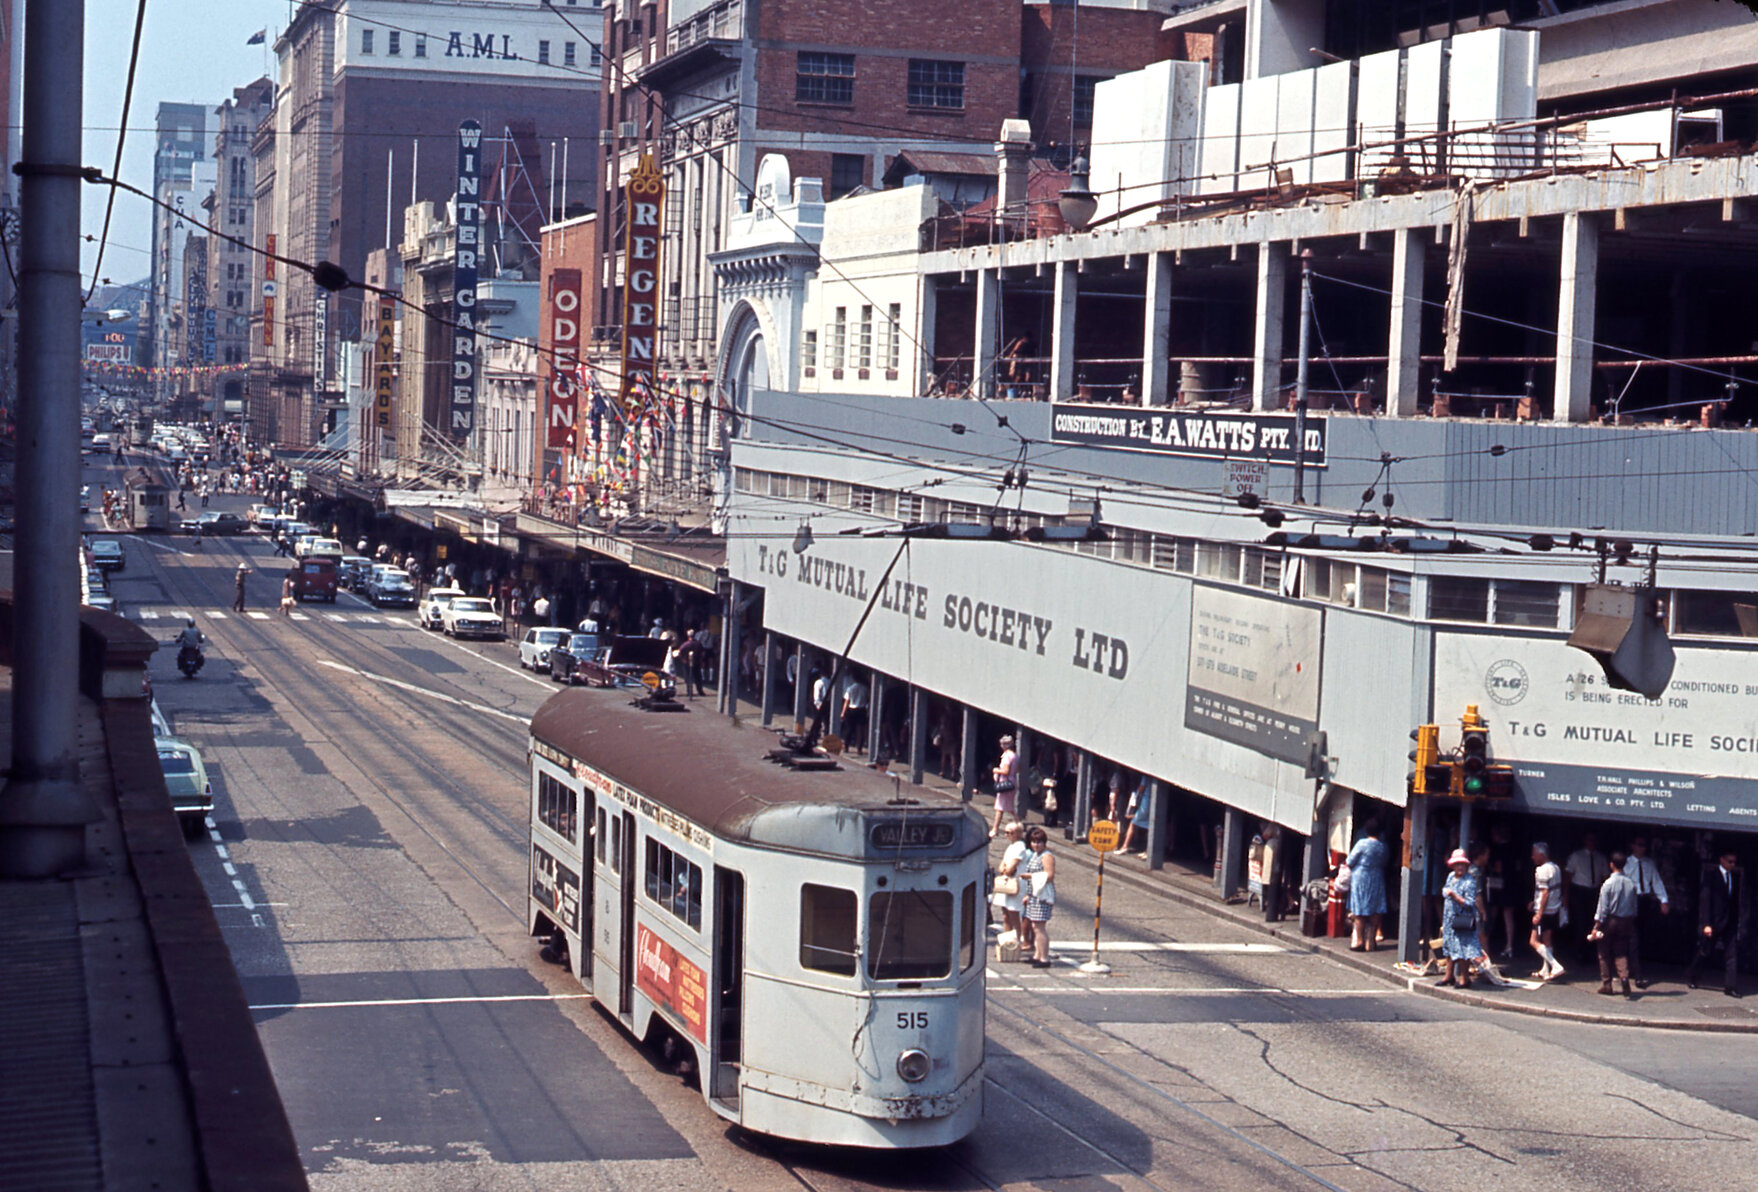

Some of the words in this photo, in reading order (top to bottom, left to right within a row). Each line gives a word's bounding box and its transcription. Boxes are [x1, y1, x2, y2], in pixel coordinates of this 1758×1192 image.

[445, 31, 523, 60] A.M.L.
[457, 128, 481, 269] WINTER
[89, 346, 122, 359] PHILIPS
[452, 289, 475, 428] GARDEN
[552, 289, 577, 427] ODEON
[379, 307, 393, 425] BAYARDS
[1055, 414, 1127, 437] CONSTRUCTION
[1260, 427, 1290, 449] PTY.
[1230, 473, 1261, 483] POWER
[798, 554, 867, 602] MUTUAL
[881, 577, 928, 621] LIFE
[944, 593, 1053, 656] SOCIETY
[1073, 627, 1129, 681] LTD
[1566, 674, 1575, 684] A
[1579, 674, 1594, 684] 26
[1671, 680, 1739, 694] CONDITIONED
[1565, 691, 1575, 701] IS
[1582, 692, 1611, 704] BEING
[1669, 698, 1688, 709] FOR
[1564, 725, 1637, 744] MUTUAL
[1654, 731, 1693, 748] LIFE
[1710, 736, 1758, 753] SOCI
[1519, 769, 1545, 778] TURNER
[1597, 785, 1627, 794] ASSOCIATE
[1633, 787, 1672, 798] ARCHITECTS
[1669, 780, 1695, 789] WILSON
[1547, 793, 1570, 802] ISLES
[1578, 795, 1598, 804] LOVE
[1686, 804, 1716, 813] LETTING
[1729, 807, 1757, 816] AGENTS
[880, 826, 927, 843] VALLEY
[897, 1011, 928, 1029] 515
